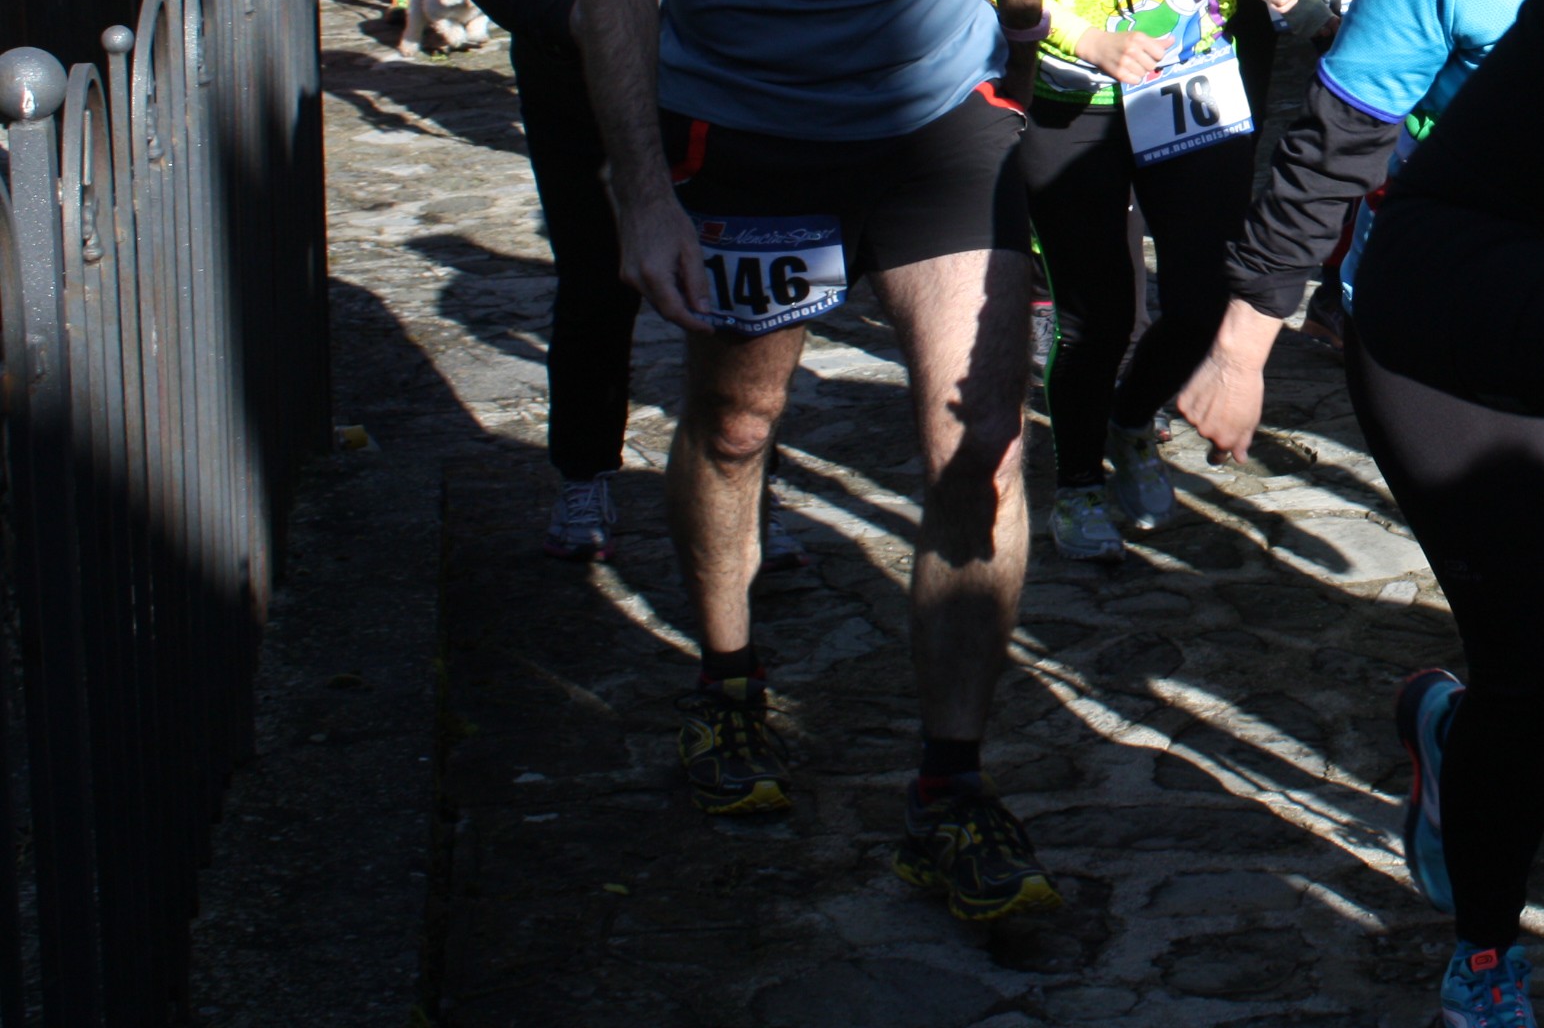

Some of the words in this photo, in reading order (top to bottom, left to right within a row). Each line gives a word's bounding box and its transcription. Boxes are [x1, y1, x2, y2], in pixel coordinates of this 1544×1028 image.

[1160, 75, 1220, 136] 78
[1143, 120, 1251, 162] www.nencinisport.it
[704, 254, 811, 315] 146
